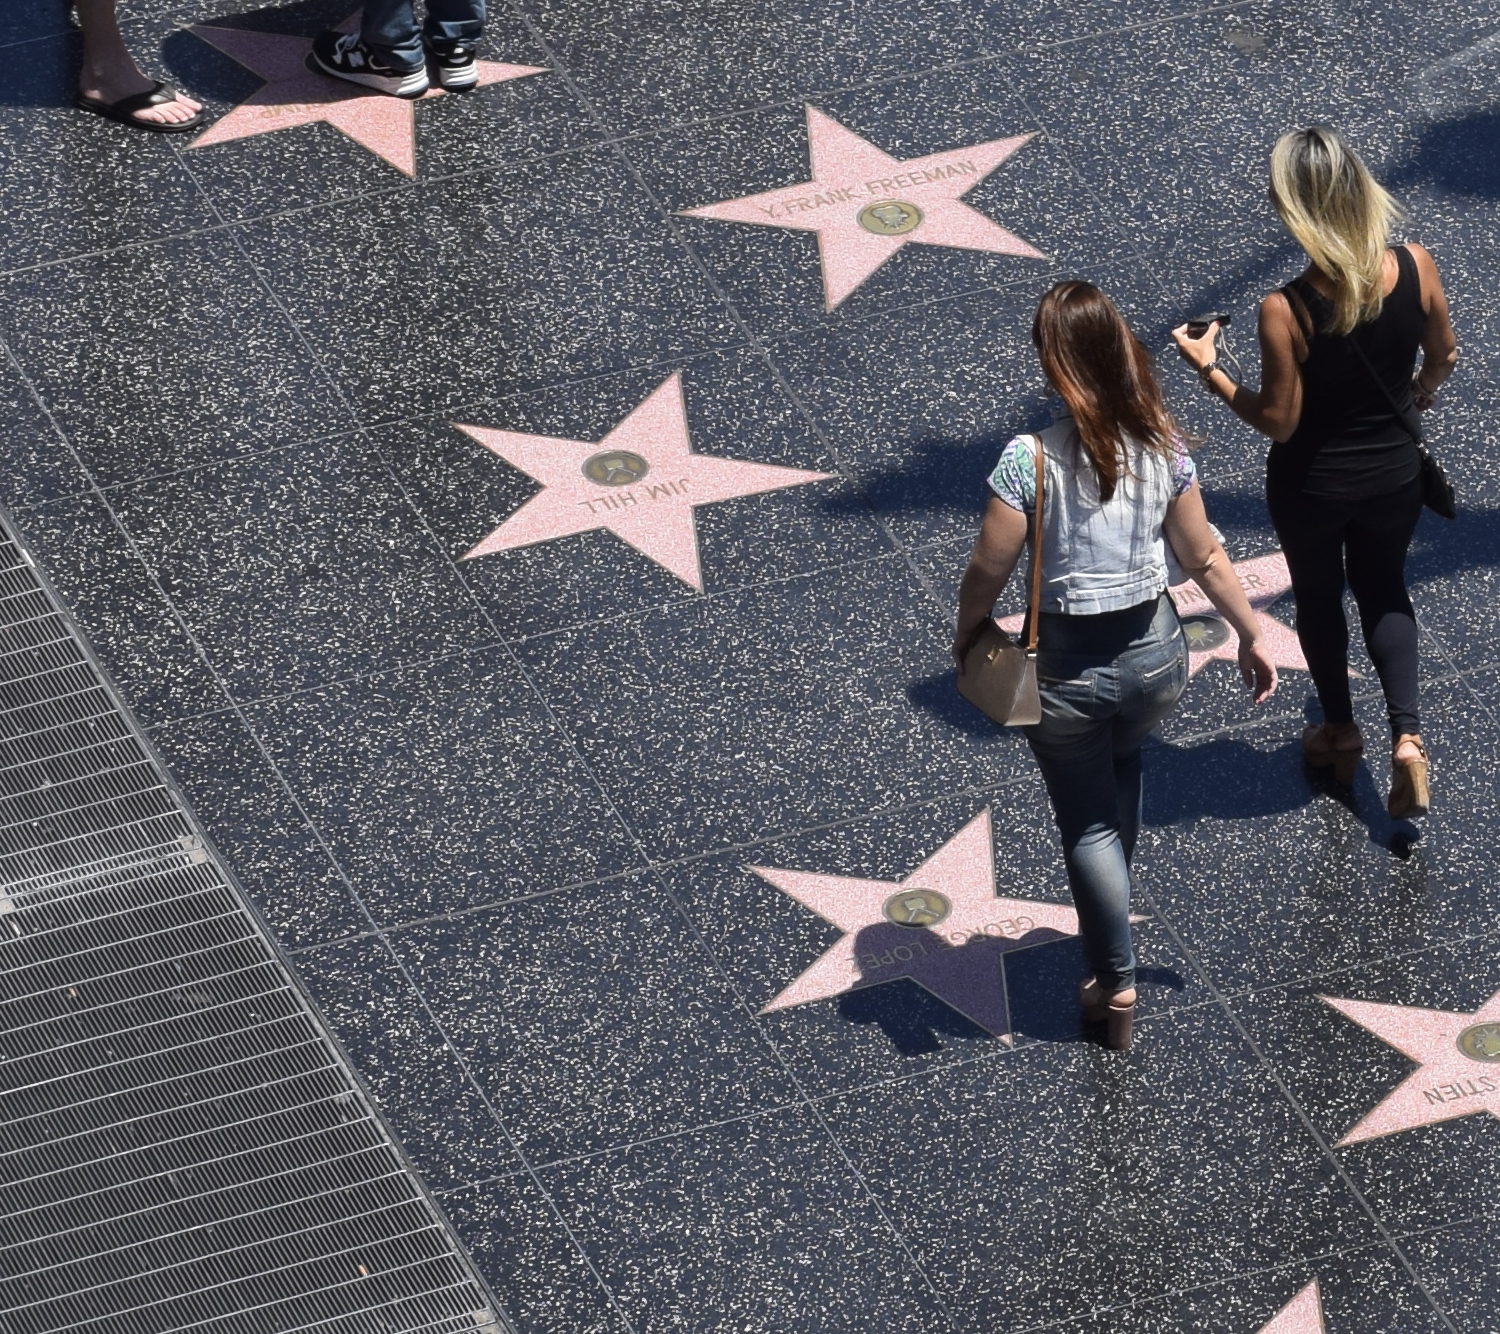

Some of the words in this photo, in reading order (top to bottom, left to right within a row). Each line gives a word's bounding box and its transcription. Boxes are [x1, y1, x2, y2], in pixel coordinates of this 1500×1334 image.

[783, 185, 862, 214] FRANK
[865, 160, 978, 195] FREEMAN
[646, 477, 690, 500] JIM
[577, 491, 638, 514] HILL
[1422, 1077, 1496, 1107] STIEN
